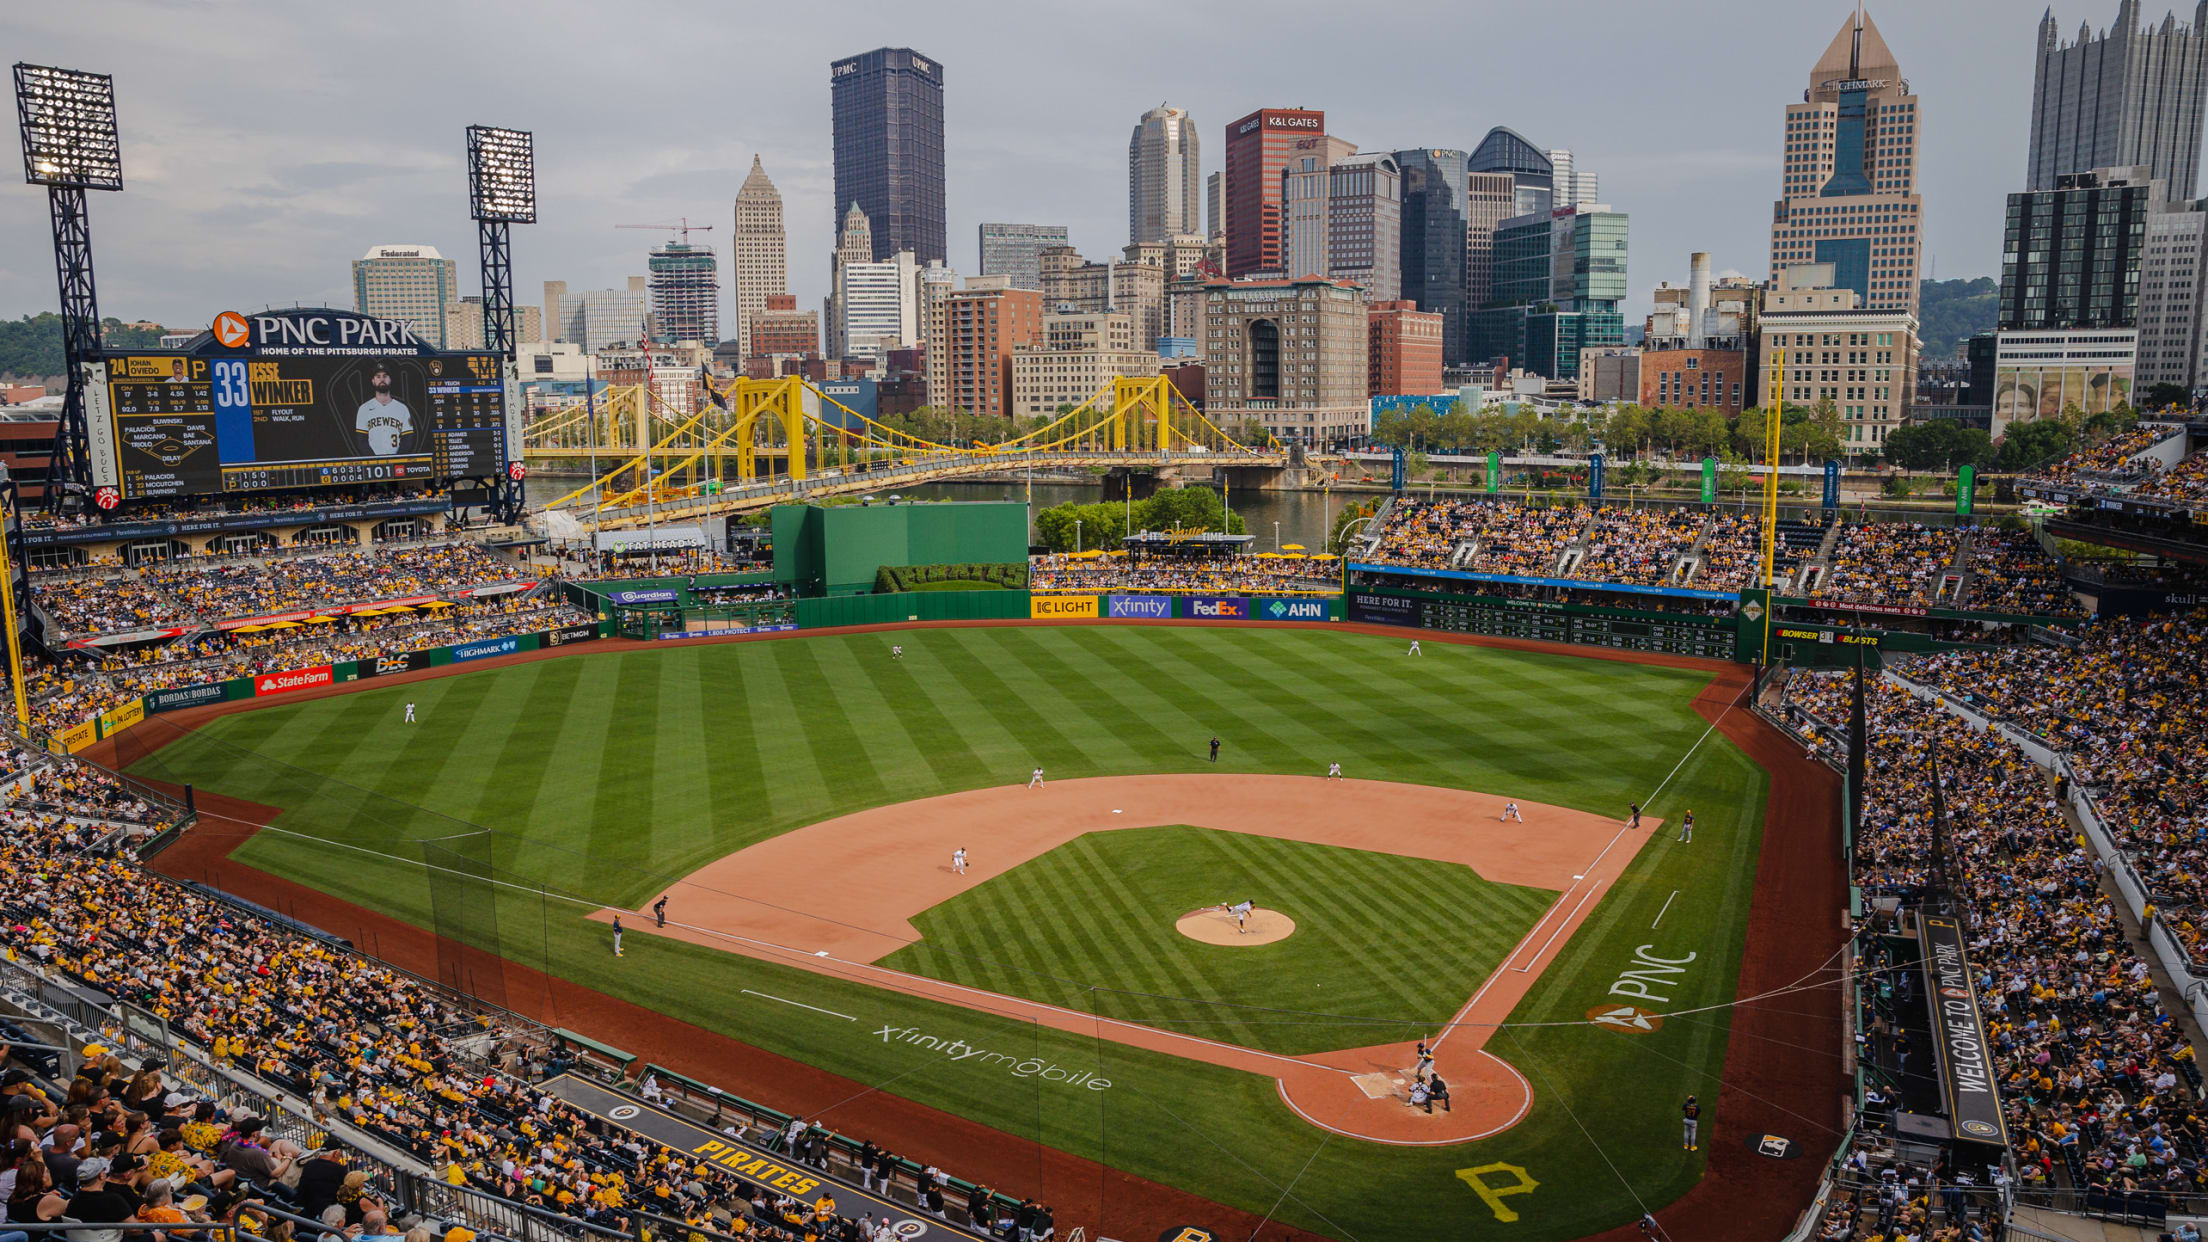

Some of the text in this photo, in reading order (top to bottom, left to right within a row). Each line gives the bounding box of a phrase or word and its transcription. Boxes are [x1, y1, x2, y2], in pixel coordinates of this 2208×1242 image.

[832, 62, 857, 78] UPMC
[912, 56, 930, 74] UPMC
[1827, 80, 1887, 92] HIGHMARK
[1269, 117, 1318, 128] K&L GATES
[380, 249, 420, 257] Federated
[254, 316, 418, 344] PNC PARK
[261, 348, 418, 356] HOME OF THE PITTSBURGH PIRATES
[110, 358, 126, 376] 24
[130, 367, 160, 375] OVIEDO
[191, 360, 206, 380] P
[248, 362, 280, 380] JESSE
[215, 362, 248, 408] 33
[252, 380, 310, 404] WINKER
[628, 538, 698, 550] FAT HEAD'S
[1162, 526, 1208, 546] Miller
[1202, 532, 1224, 541] TIME
[621, 592, 672, 602] Guardian
[1356, 595, 1413, 608] HERE FOR IT.
[2164, 593, 2196, 604] skull
[1036, 602, 1093, 614] IC LIGHT
[1114, 598, 1166, 616] xfinity
[1193, 600, 1238, 616] FedEx
[1288, 604, 1322, 616] AHN
[1856, 604, 1884, 612] delicious
[562, 630, 588, 640] BETMGM
[1782, 629, 1818, 640] BOWSER
[1842, 635, 1878, 646] BLASTS
[460, 646, 500, 658] HIGHMARK
[376, 654, 410, 673] DLC
[158, 686, 220, 704] BORDAS BORDAS
[124, 705, 142, 722] LOTTERY
[64, 729, 88, 745] TRISTATE
[1608, 944, 1696, 1002] PNC
[1934, 942, 1988, 1093] WELCOME TO PNC PARK
[693, 1140, 820, 1195] PIRATES
[1454, 1160, 1541, 1223] P
